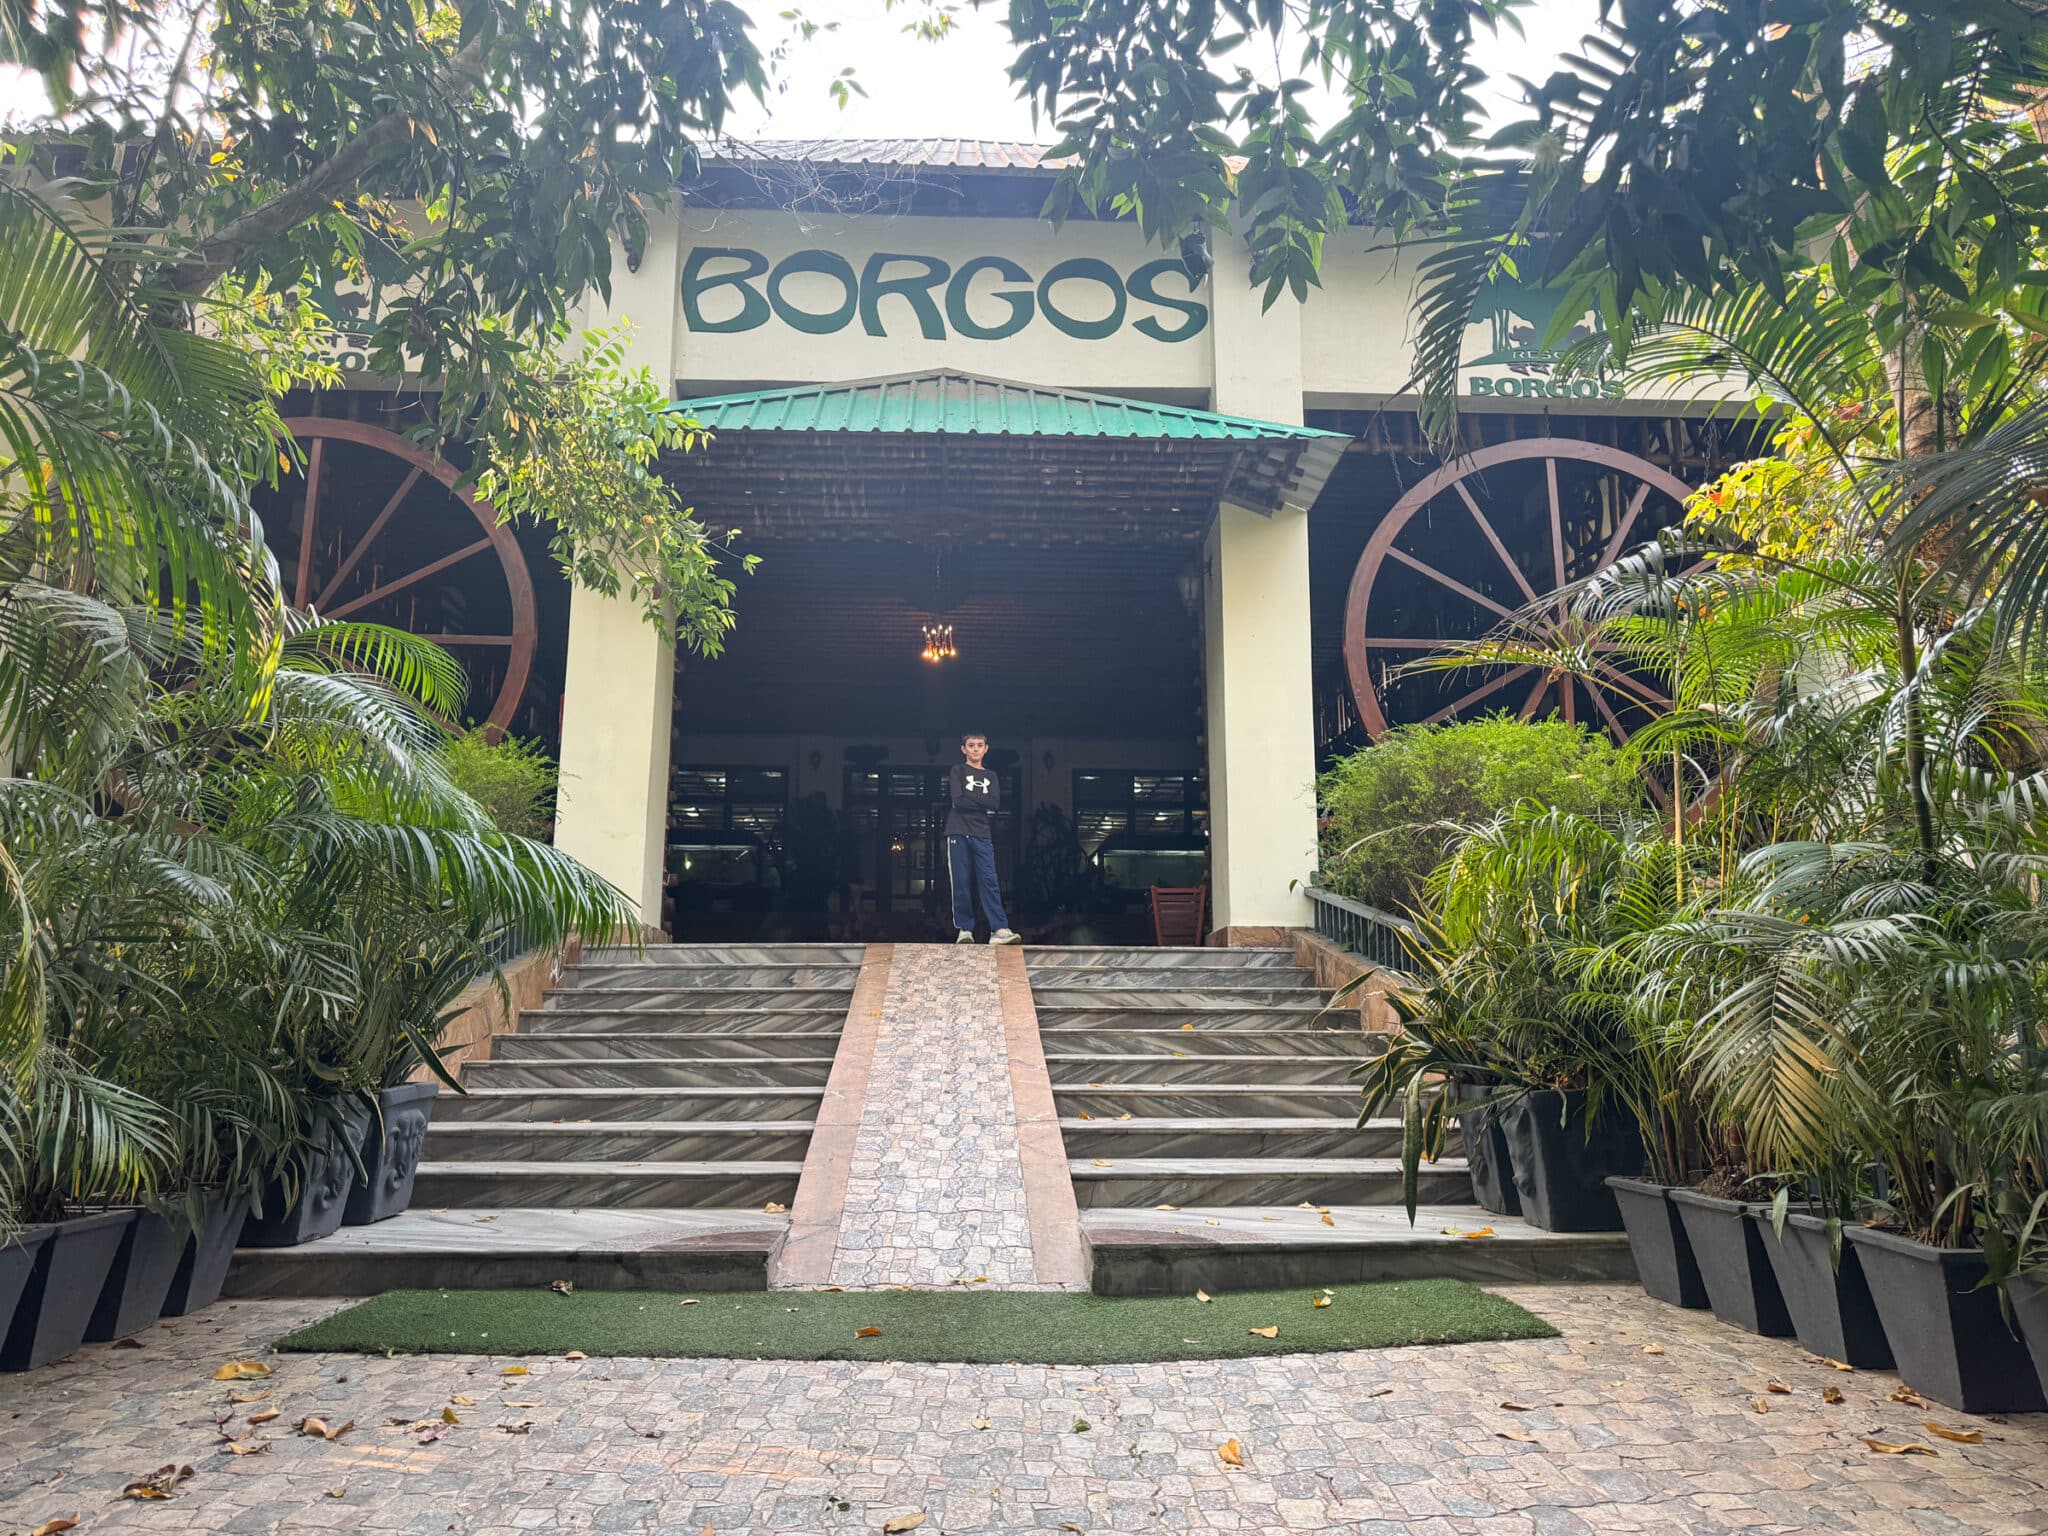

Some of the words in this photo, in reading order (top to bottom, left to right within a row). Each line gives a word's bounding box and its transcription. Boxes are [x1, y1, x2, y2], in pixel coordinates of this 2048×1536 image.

[681, 247, 1208, 343] BORGOS
[272, 319, 366, 330] RORT
[1469, 376, 1626, 399] BORGOS
